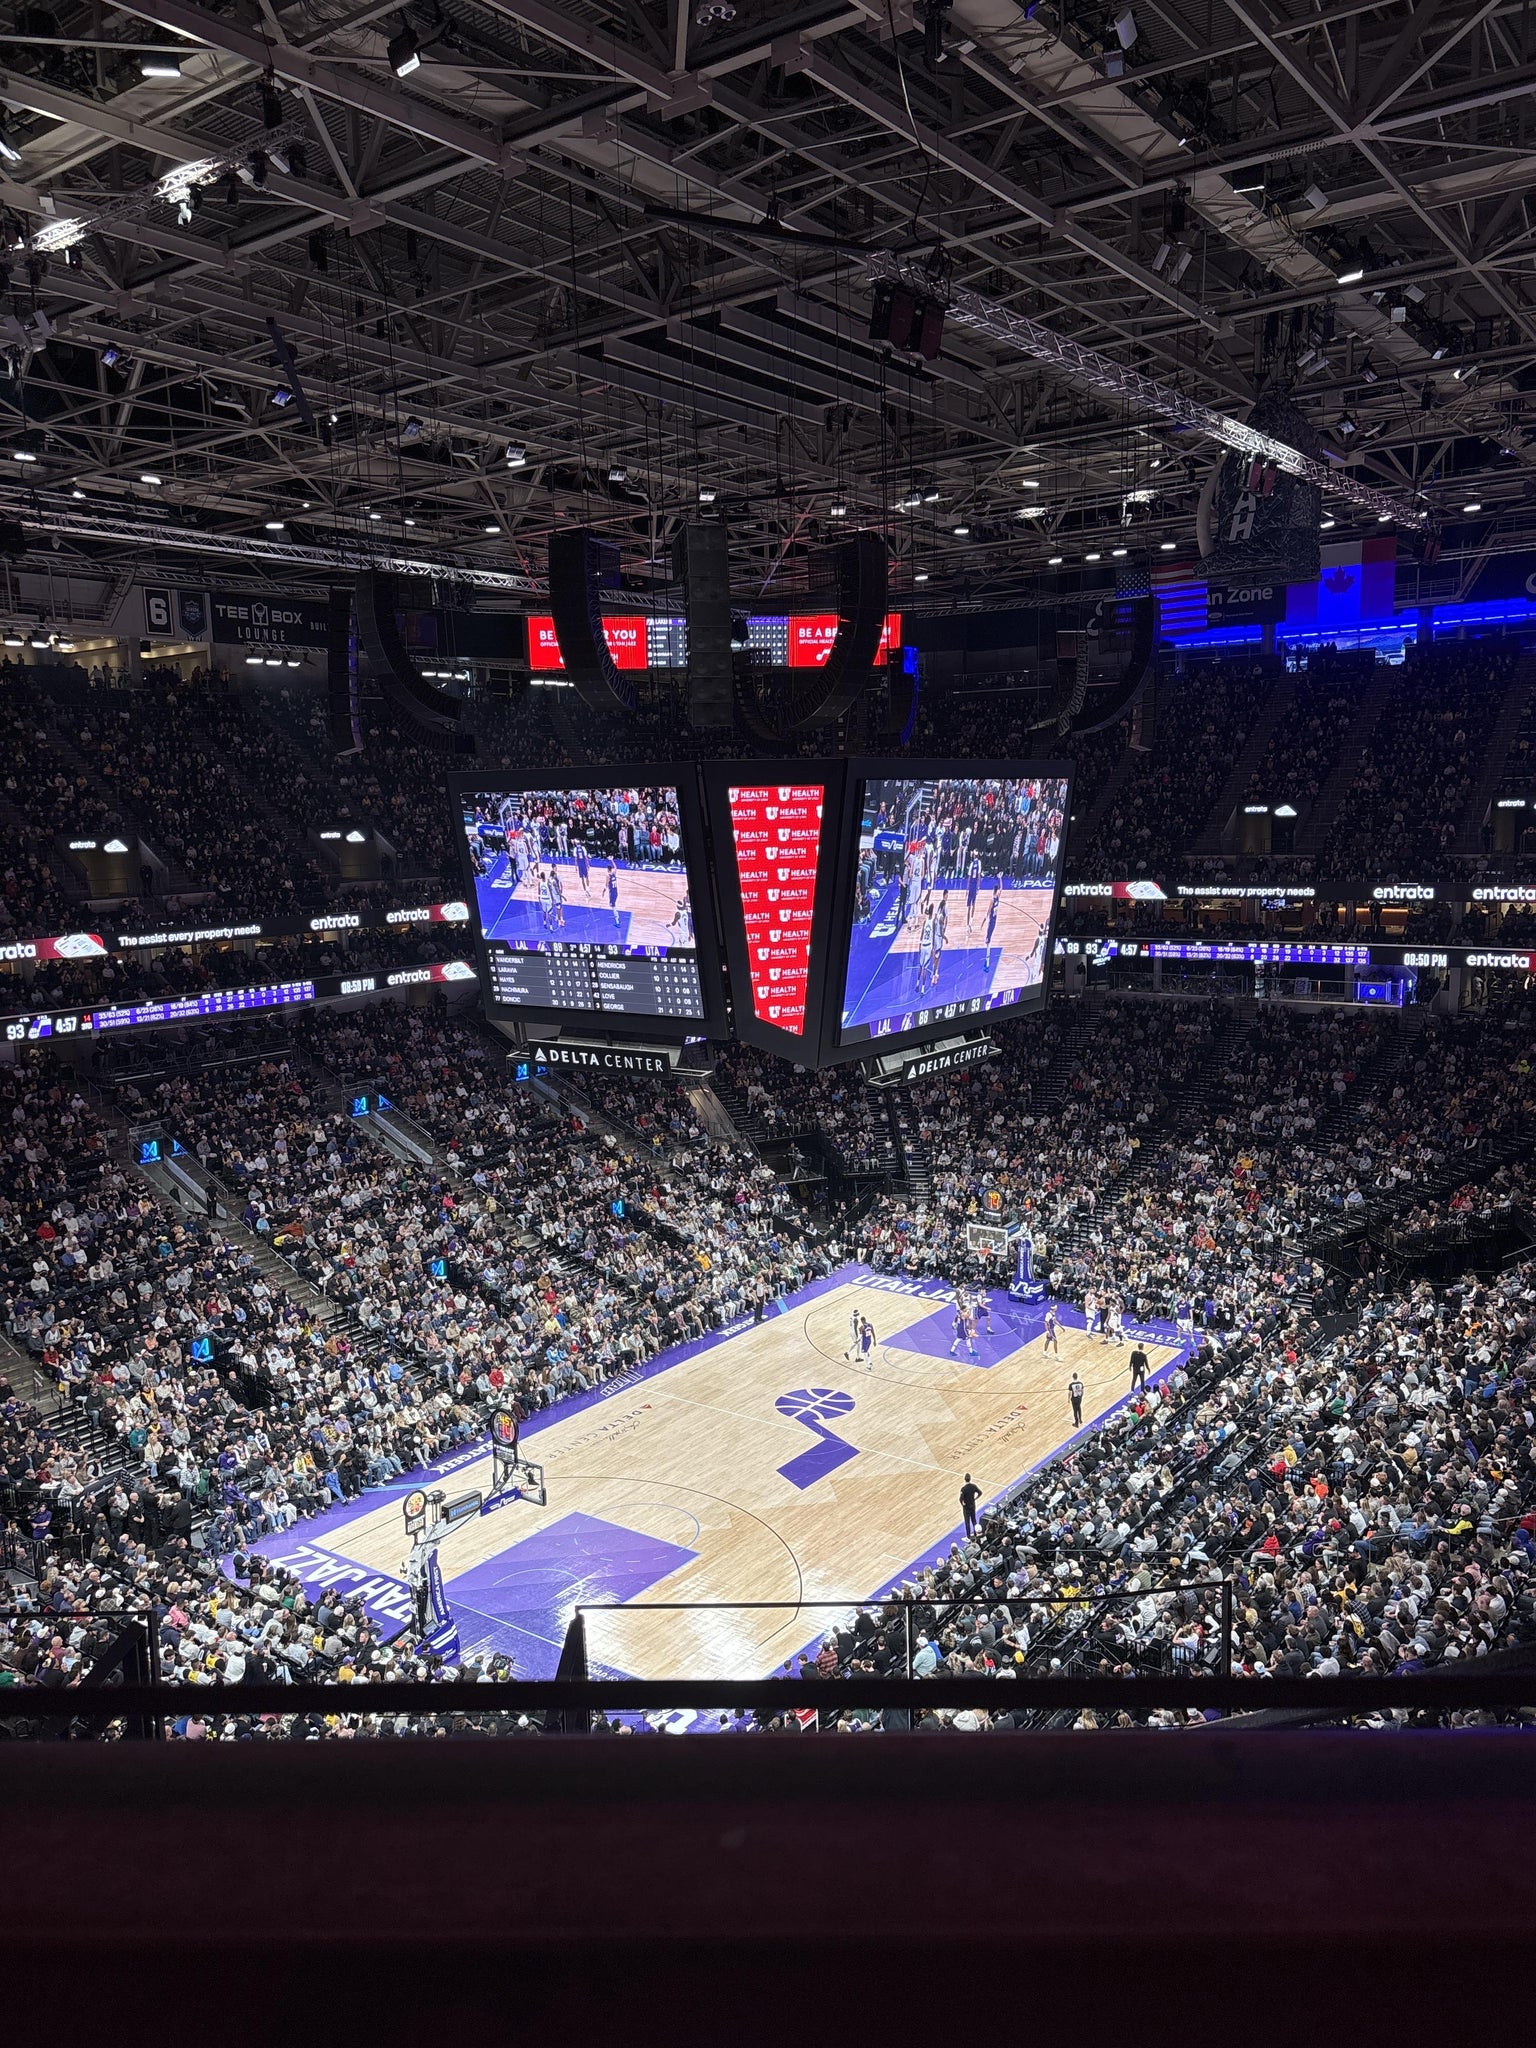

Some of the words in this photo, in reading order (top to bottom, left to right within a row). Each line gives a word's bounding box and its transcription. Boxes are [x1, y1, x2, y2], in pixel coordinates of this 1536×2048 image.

[1227, 587, 1273, 604] Zone
[150, 598, 167, 625] 6
[215, 604, 249, 620] TEE
[271, 609, 303, 625] BOX
[310, 621, 328, 632] BUIL
[800, 628, 811, 637] BE
[815, 628, 822, 637] A
[237, 626, 286, 642] LOUNGE
[540, 630, 554, 639] BE
[612, 630, 637, 639] YOU
[740, 790, 768, 799] HEALTH
[791, 789, 819, 798] HEALTH
[779, 808, 807, 816] HEALTH
[740, 831, 768, 839] HEALTH
[791, 829, 819, 837] HEALTH
[779, 847, 807, 856] HEALTH
[642, 864, 687, 873] PAC
[740, 871, 768, 879] HEALTH
[1023, 880, 1055, 888] PAC
[1064, 883, 1112, 897] entrata
[780, 889, 808, 897] HEALTH
[1177, 886, 1193, 895] The
[1194, 886, 1221, 896] assist
[1221, 888, 1246, 898] every
[1246, 887, 1285, 898] property
[1286, 887, 1315, 897] needs
[1373, 885, 1434, 899] entrata
[1472, 886, 1536, 900] entrata
[386, 908, 430, 923] entrata
[792, 909, 813, 918] HEALT
[310, 914, 359, 931] entrata
[118, 936, 139, 947] The
[140, 933, 168, 945] assist
[168, 931, 199, 944] every
[199, 927, 234, 942] property
[233, 924, 261, 938] needs
[782, 930, 809, 938] HEALTH
[0, 943, 37, 960] rata
[515, 940, 528, 950] LAL
[608, 945, 618, 955] 93
[645, 946, 660, 956] UTA
[771, 948, 797, 956] HEALTH
[1067, 942, 1079, 954] 88
[1085, 943, 1098, 954] 93
[1120, 944, 1137, 956] 4:57
[597, 962, 626, 970] HENDRICKS
[1404, 953, 1429, 966] 08:50
[1431, 954, 1447, 967] PM
[1466, 953, 1530, 968] entrata
[387, 969, 431, 986] entrata
[782, 968, 808, 976] HEALTH
[363, 978, 375, 991] PM
[600, 982, 634, 990] SENSABAUGH
[770, 986, 796, 994] HEALTH
[603, 1003, 624, 1011] GEORGE
[877, 1019, 891, 1035] LAL
[918, 1011, 929, 1025] 88
[944, 1004, 956, 1018] 4:57
[971, 998, 980, 1012] 93
[1002, 990, 1015, 1005] UTA
[55, 1017, 77, 1033] 4:57
[83, 1014, 91, 1022] 14
[6, 1024, 25, 1040] 93
[550, 1049, 600, 1066] DELTA
[604, 1054, 664, 1072] CENTER
[919, 1055, 950, 1075] DELTA
[953, 1044, 988, 1064] CENTER
[851, 1274, 923, 1295] UTAH
[1123, 1328, 1187, 1344] HEALTH
[597, 1410, 643, 1432] DELTA
[985, 1411, 1022, 1433] DELTA
[546, 1432, 599, 1459] CENTER
[950, 1433, 990, 1460] CENTER
[429, 1440, 493, 1475] EATGEEK
[269, 1545, 368, 1588] JAZZ
[344, 1577, 413, 1624] TAH
